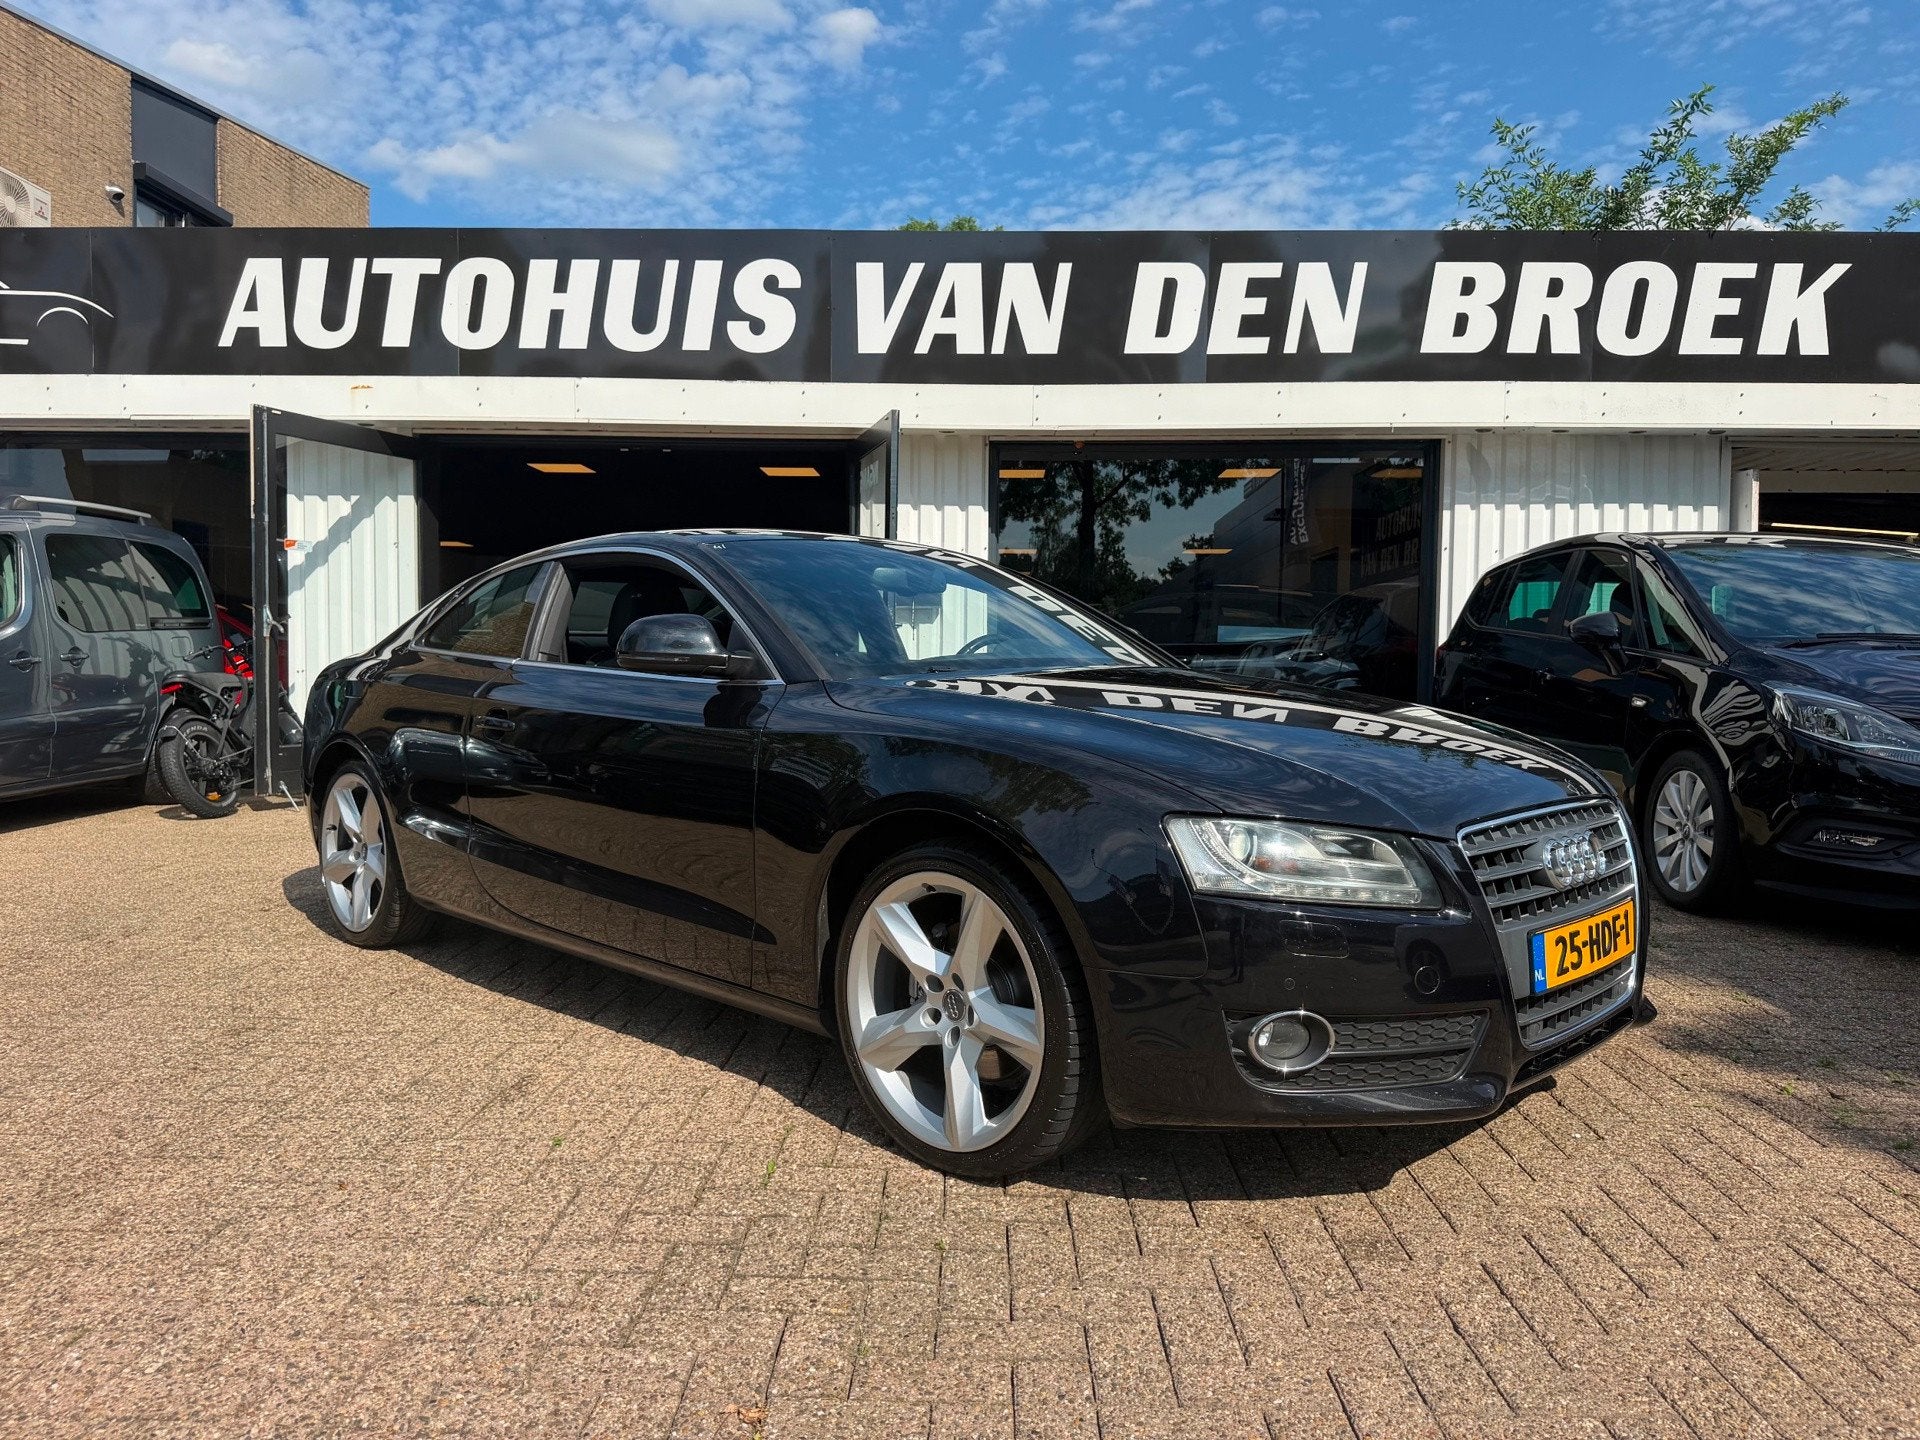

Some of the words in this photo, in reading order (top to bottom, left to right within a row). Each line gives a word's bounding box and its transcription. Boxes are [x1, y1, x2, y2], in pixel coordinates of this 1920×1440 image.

[218, 257, 802, 353] AUTOHUIS
[856, 262, 1072, 354] VAN
[1124, 262, 1368, 354] DEN
[1420, 261, 1852, 356] BROEK
[1534, 969, 1545, 981] NL
[1555, 909, 1630, 977] 25-HDF-1
